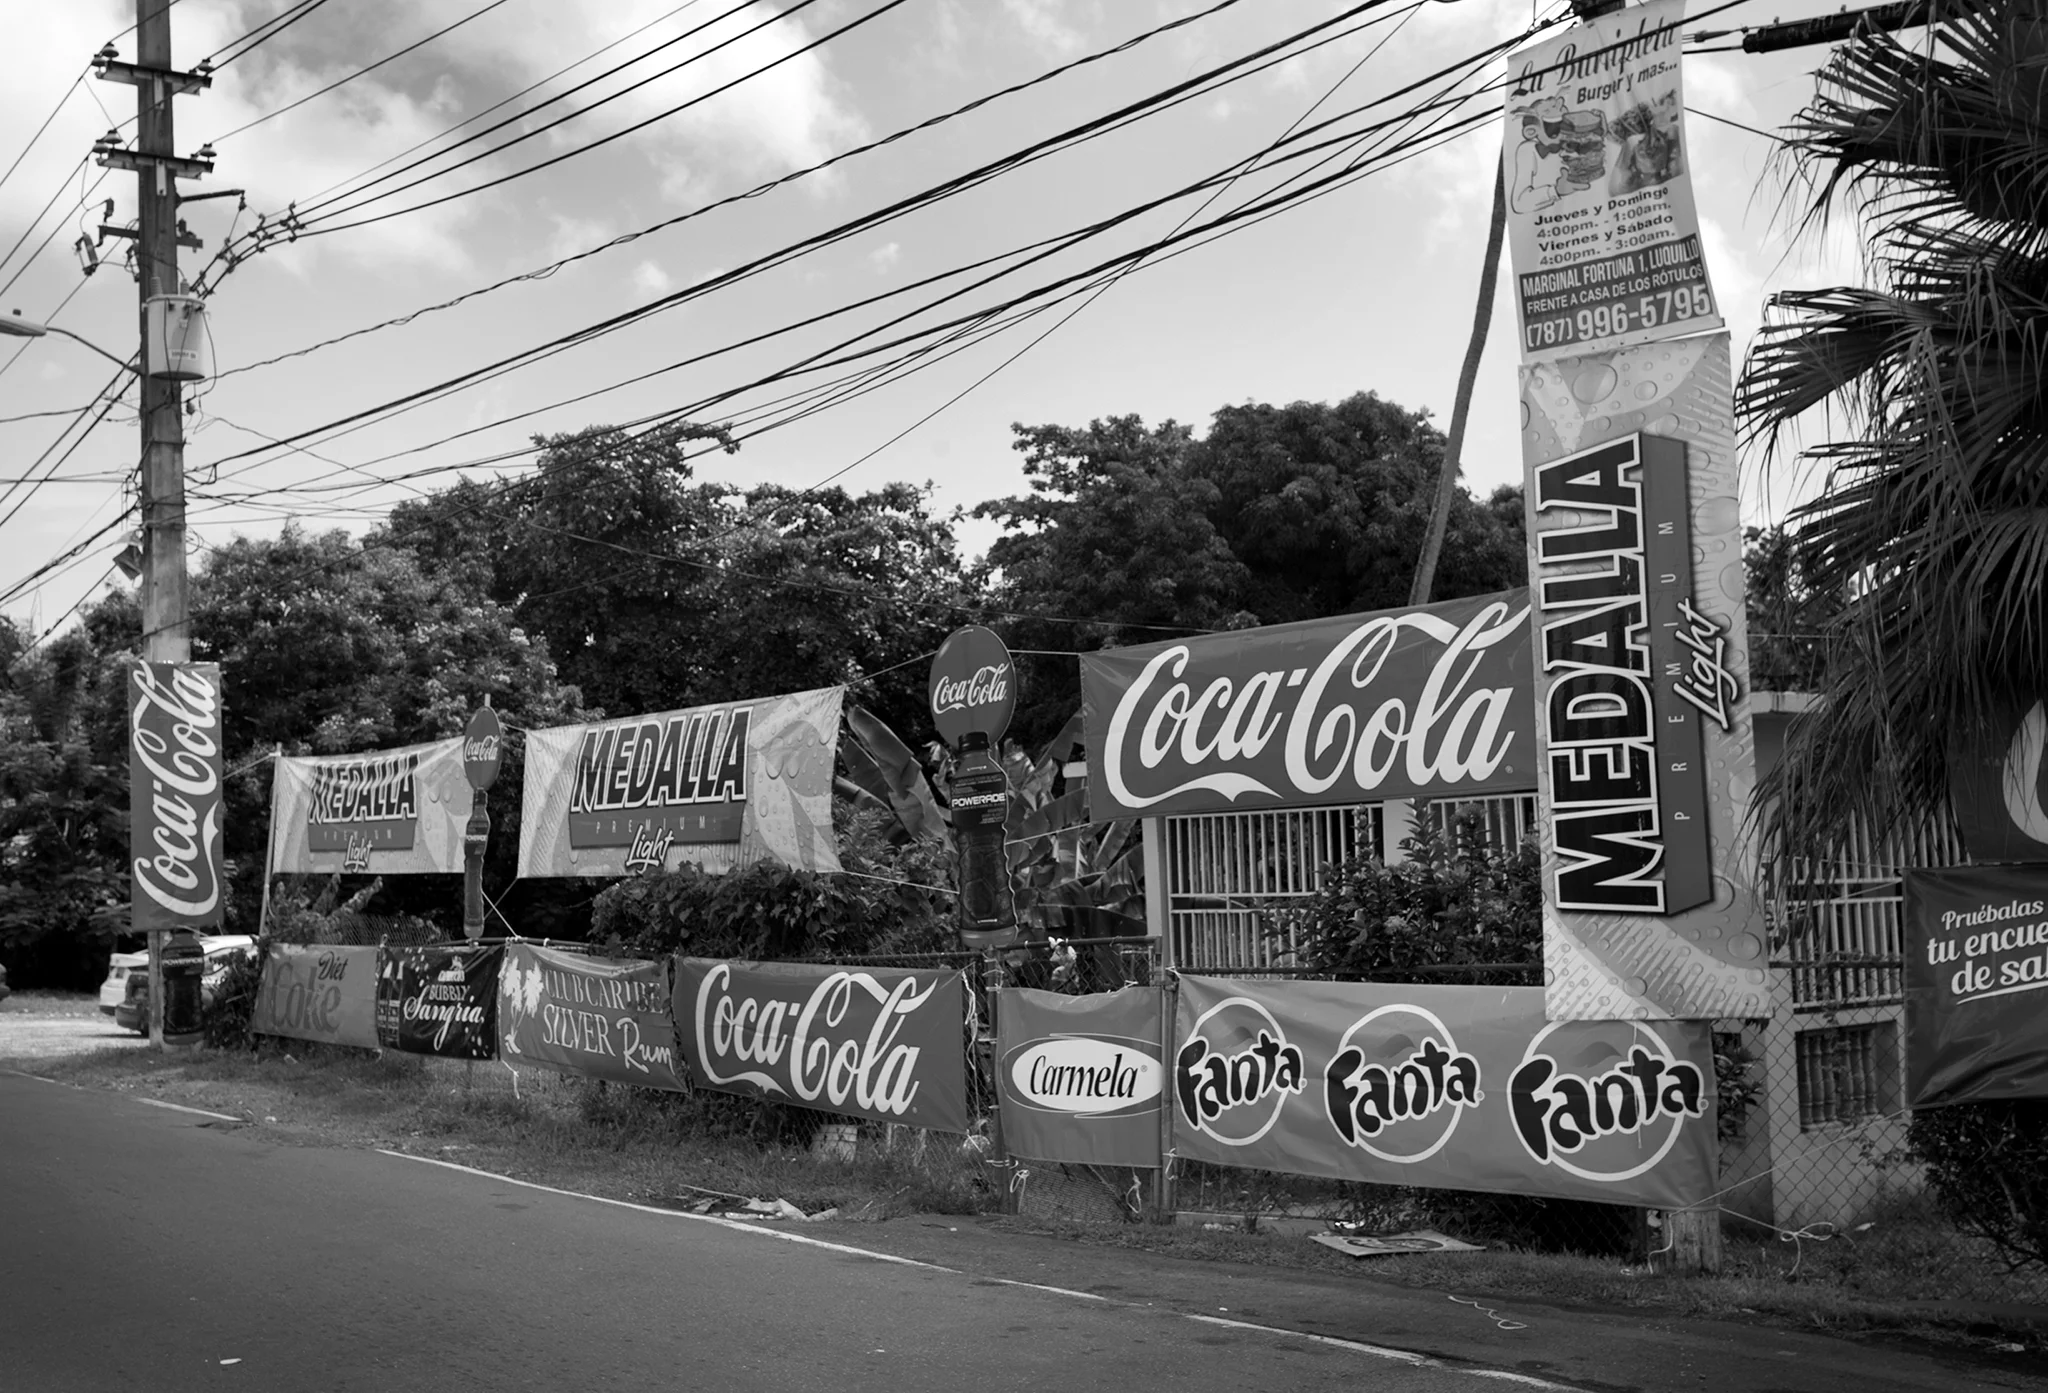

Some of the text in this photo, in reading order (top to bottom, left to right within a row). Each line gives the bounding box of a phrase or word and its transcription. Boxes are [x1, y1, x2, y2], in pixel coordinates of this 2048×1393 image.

[1626, 73, 1634, 92] y
[1534, 187, 1669, 226] Jueves y Domingo
[1536, 220, 1599, 239] 4:00pm.
[1613, 202, 1672, 222] 1:00am.
[1539, 214, 1673, 252] Viernes y Sábado
[1540, 247, 1601, 266] 4:00pm.
[1615, 229, 1676, 250] 3:00am.
[1523, 269, 1582, 297] MARGINAL
[1583, 255, 1635, 285] FORTUNA
[1649, 238, 1700, 270] LUQUILLO
[1526, 263, 1703, 315] FRENTE A CASA DE LOS RÓTULOS
[1526, 283, 1711, 348] (787) 996-5795
[932, 662, 1010, 714] Coca-Cola
[1533, 431, 1666, 914] MEDALLA
[1658, 520, 1690, 822] PREMIUM
[1673, 596, 1740, 731] Light
[1104, 601, 1532, 808] Coca-Cola
[464, 735, 500, 762] Coca-Cola
[569, 705, 754, 814] MEDALLA
[132, 659, 220, 917] Coca-Cola
[308, 750, 421, 825] MEDALLA
[951, 792, 1006, 808] POWERADE
[344, 834, 374, 872] Light
[626, 824, 675, 874] Light
[1941, 899, 2045, 931] Pruébalas
[317, 951, 348, 982] Diet
[1926, 936, 1960, 966] tu
[267, 955, 342, 1035] Coke
[428, 984, 471, 1001] BUBBLY
[544, 969, 664, 1014] CLUB CARIBE
[1951, 960, 1995, 996] de
[542, 1003, 676, 1076] SILVER Rum
[695, 963, 939, 1116] Coca-Cola
[1029, 1054, 1141, 1099] Carmela
[1176, 1029, 1305, 1131] Fanta
[1324, 1036, 1482, 1148] Fanta
[1507, 1042, 1704, 1165] Fanta
